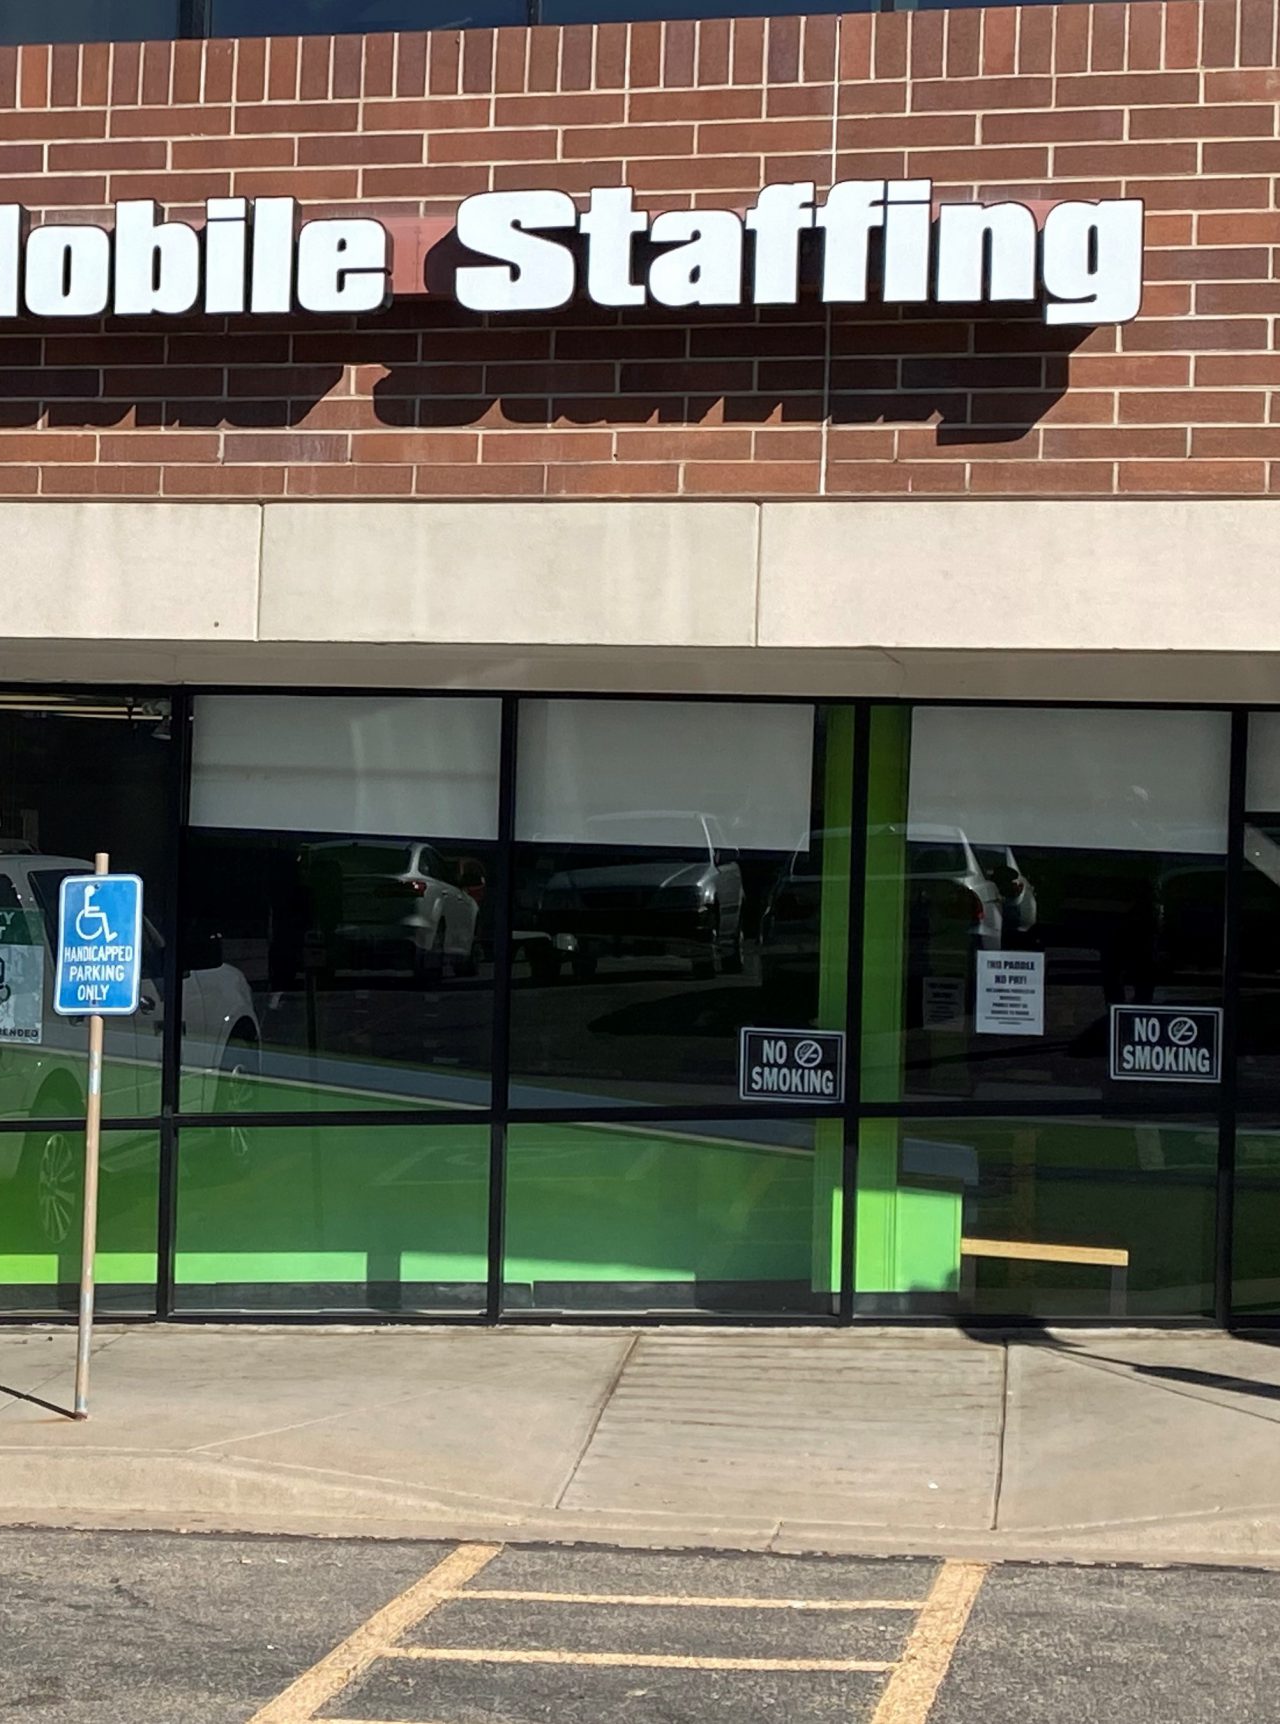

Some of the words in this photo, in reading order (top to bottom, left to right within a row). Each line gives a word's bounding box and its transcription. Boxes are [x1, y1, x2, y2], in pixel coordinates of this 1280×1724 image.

[454, 179, 1145, 325] Staffing
[64, 945, 132, 963] HANDICAPPED
[69, 965, 125, 982] PARKING
[77, 984, 110, 1001] ONLY
[1134, 1017, 1160, 1043] NO
[762, 1039, 787, 1064] NO
[1123, 1045, 1210, 1073] SMOKING
[751, 1066, 834, 1094] SMOKING
